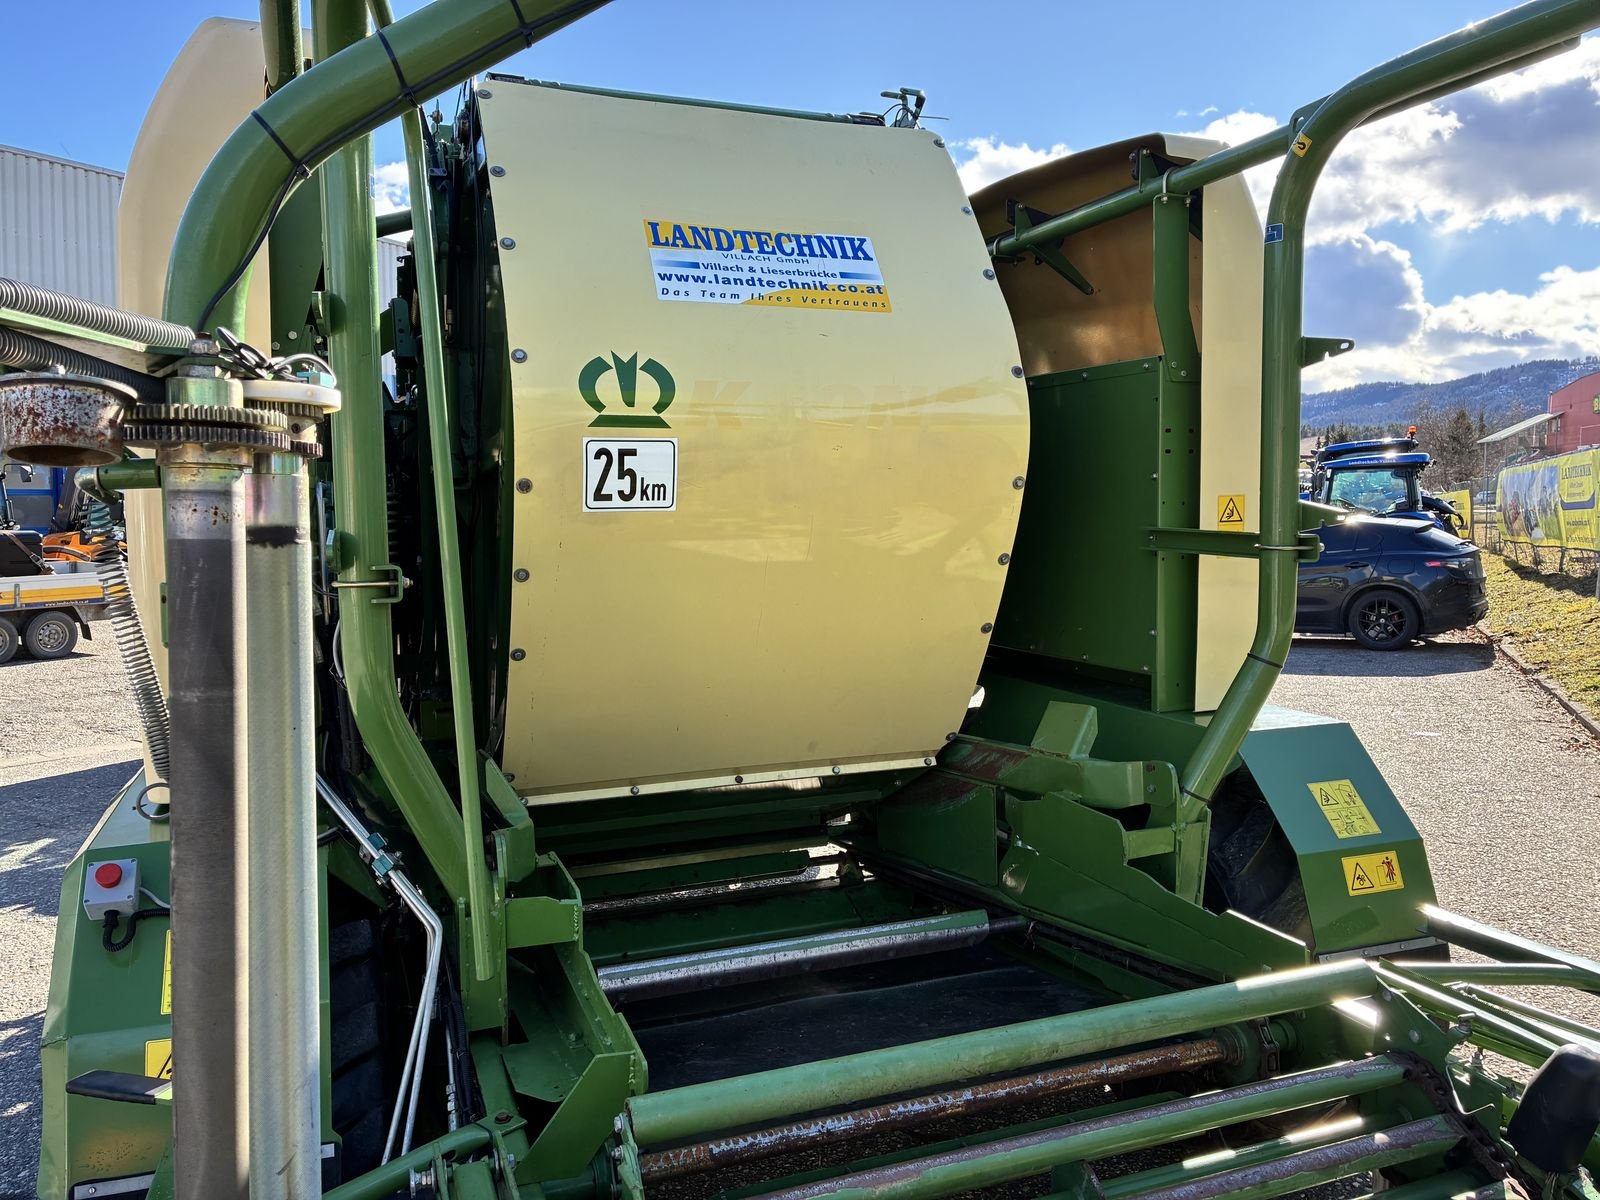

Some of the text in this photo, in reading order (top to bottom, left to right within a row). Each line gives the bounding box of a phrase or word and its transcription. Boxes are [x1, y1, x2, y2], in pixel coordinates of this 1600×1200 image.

[647, 222, 874, 261] LANDTECHNIK
[721, 252, 810, 265] VILLACH GmbH
[701, 262, 838, 279] Villach & Lieserbrücke
[657, 272, 884, 295] www.landtechnik.co.at
[661, 287, 887, 309] Das Team Ihres Vertrauens
